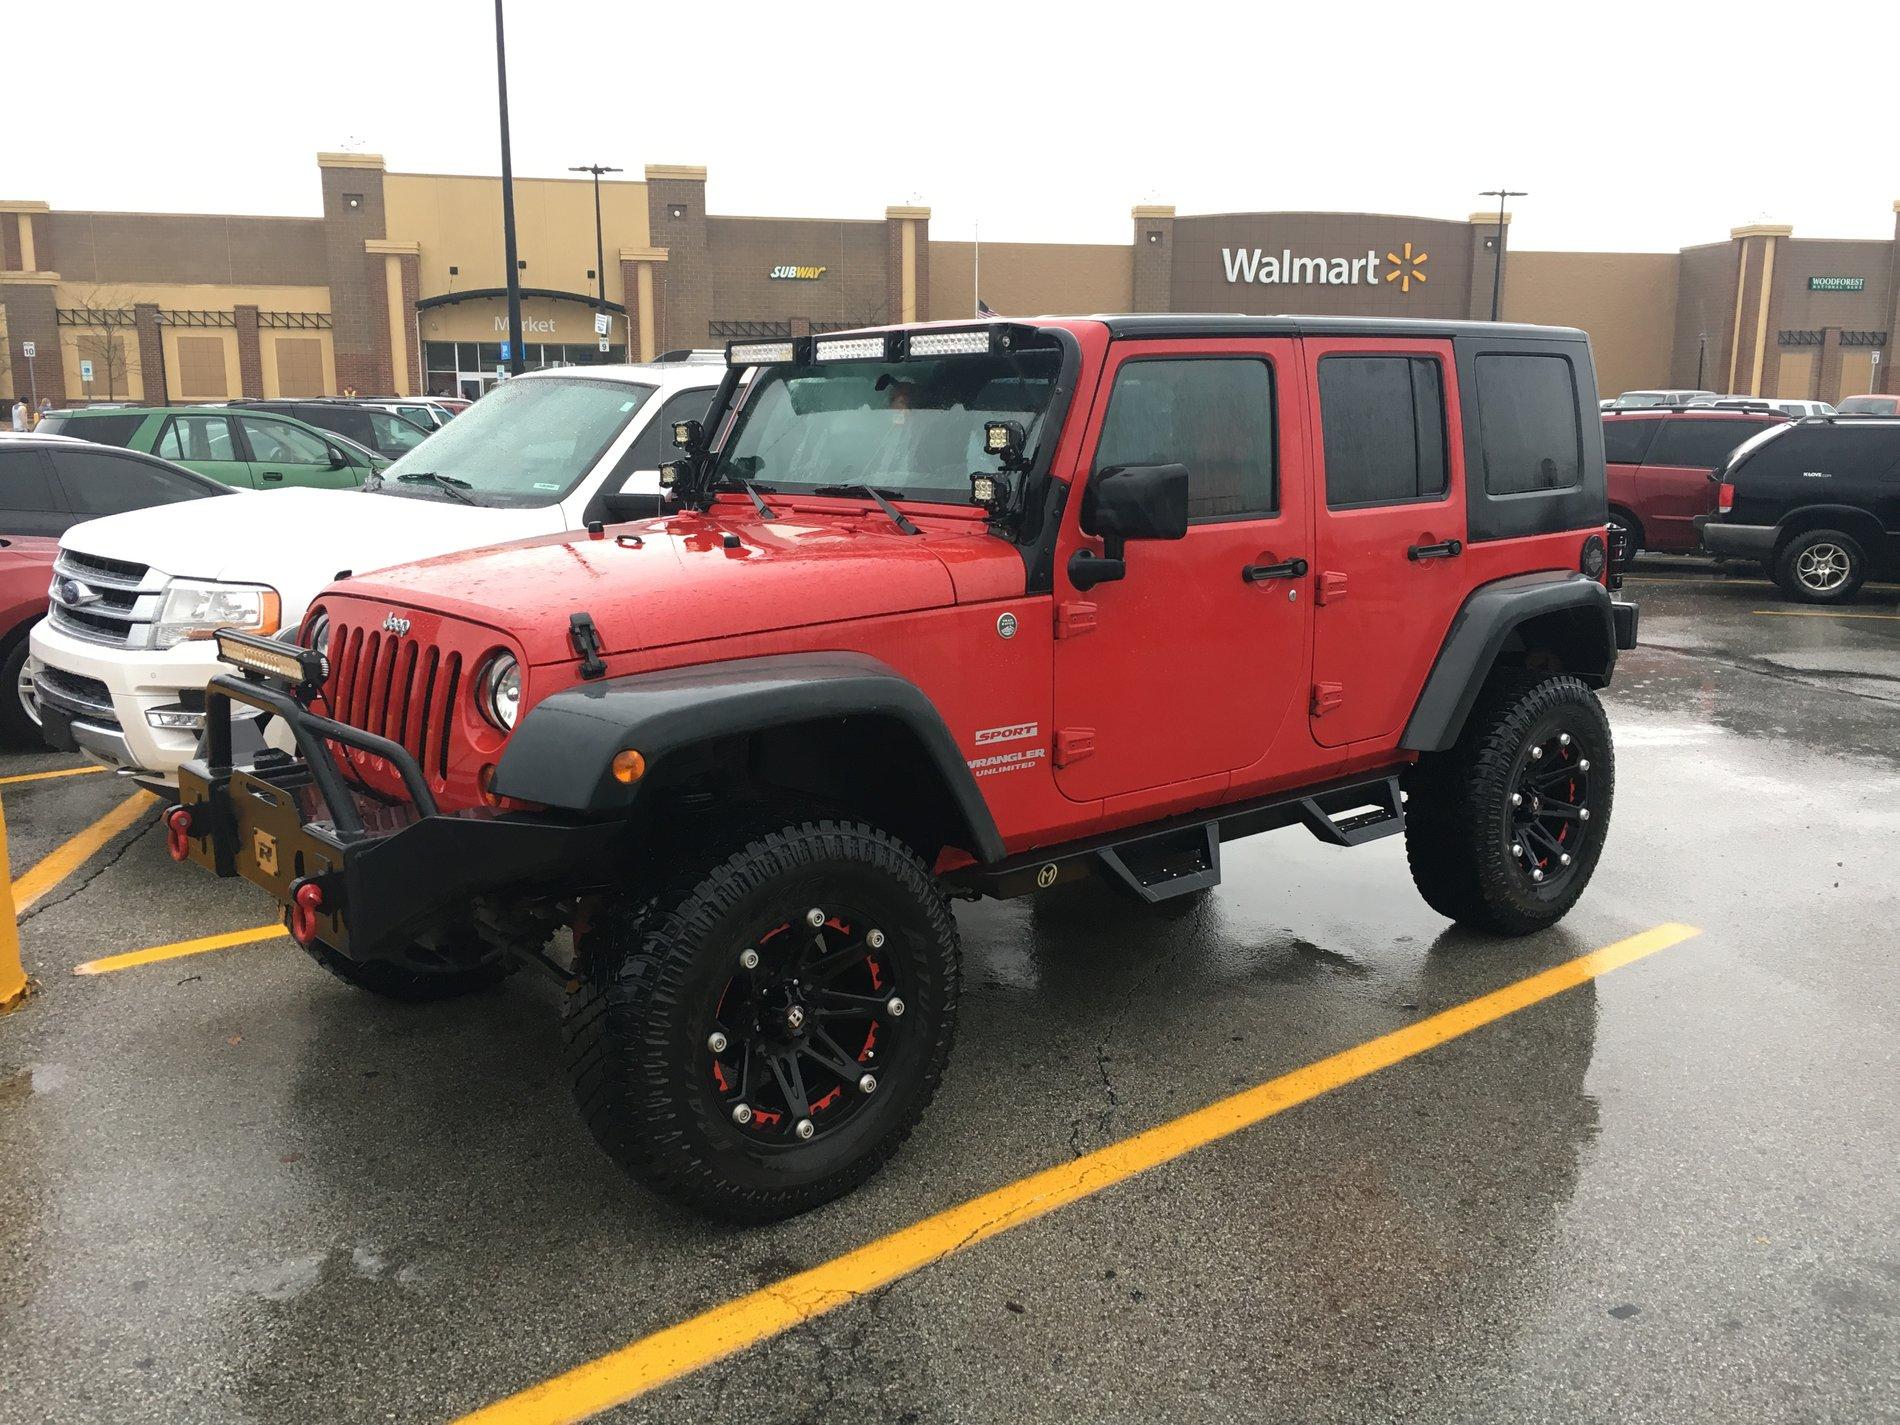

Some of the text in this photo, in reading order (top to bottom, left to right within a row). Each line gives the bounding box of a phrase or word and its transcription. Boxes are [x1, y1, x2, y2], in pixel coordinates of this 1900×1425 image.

[770, 266, 826, 278] SUBWAY
[1222, 248, 1380, 284] Walmart
[1812, 277, 1864, 285] WOODFOREST
[494, 316, 556, 333] Mrket
[24, 348, 34, 356] 10
[601, 343, 607, 351] 9
[383, 611, 410, 637] Jeep
[979, 725, 1034, 741] SPORT
[976, 761, 1036, 777] UNLIMITED
